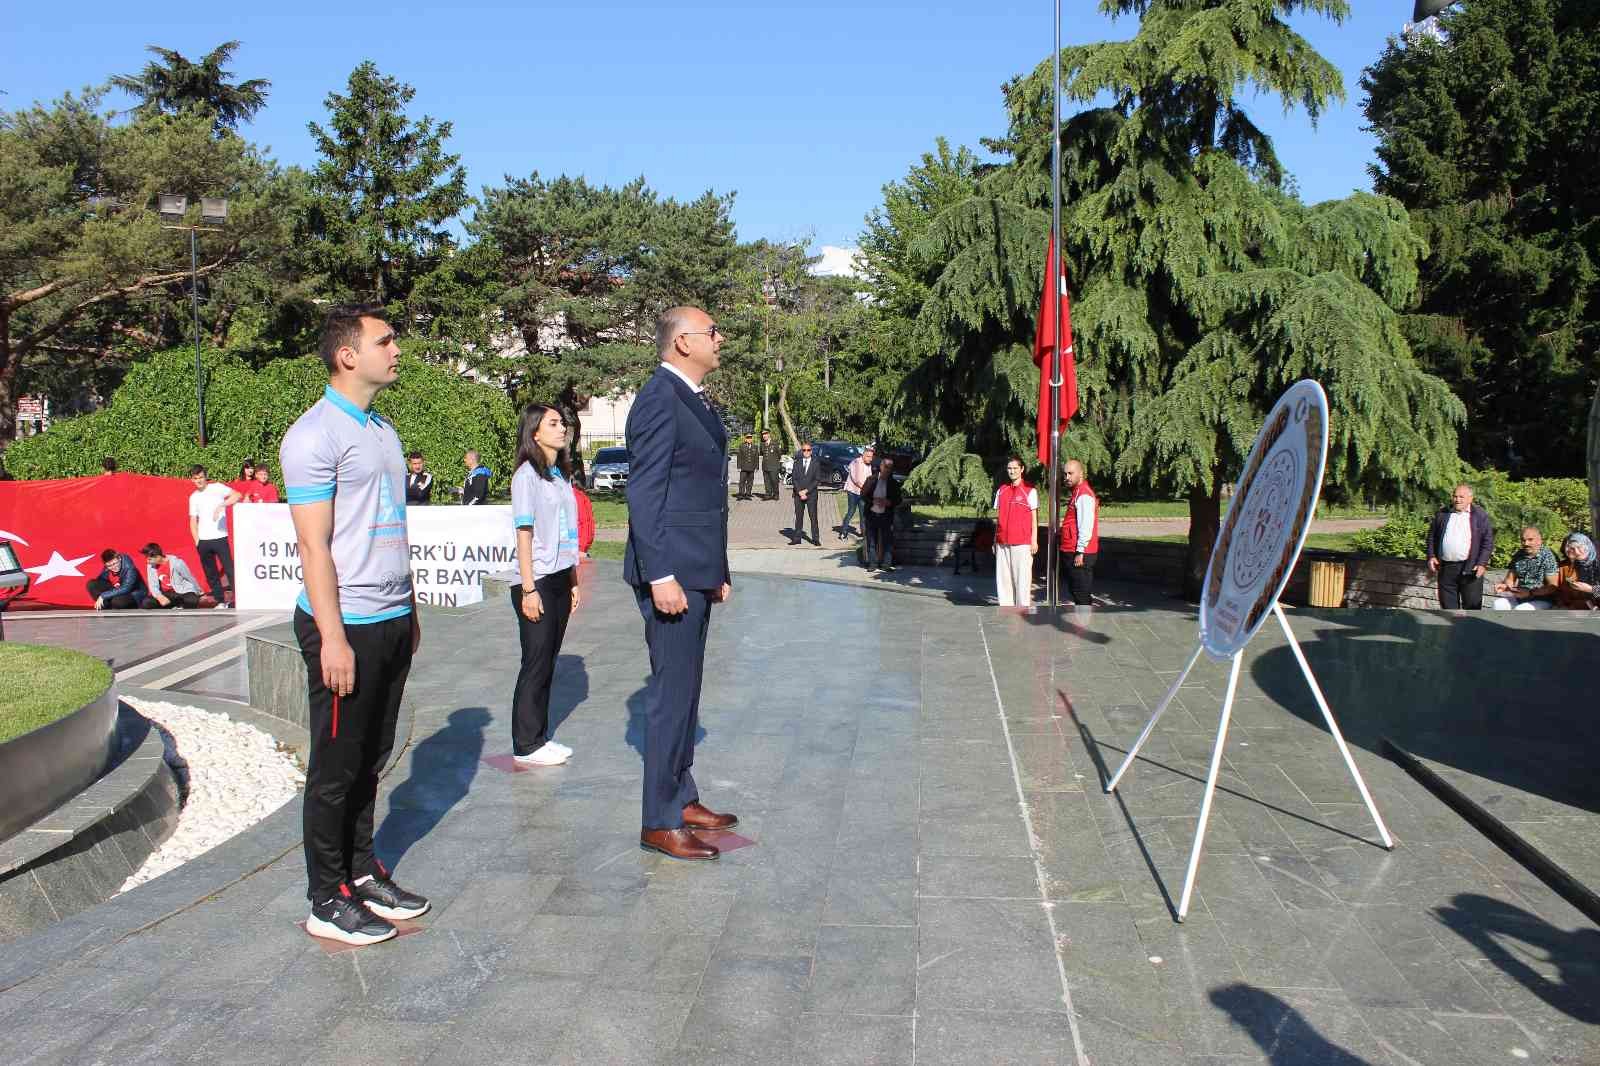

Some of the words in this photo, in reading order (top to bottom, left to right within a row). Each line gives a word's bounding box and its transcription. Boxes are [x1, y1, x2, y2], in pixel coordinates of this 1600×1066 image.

[259, 541, 279, 557] 19
[285, 542, 301, 558] M
[409, 541, 456, 561] RK'Ü
[254, 564, 304, 584] GENÇ
[436, 569, 489, 586] BAYR
[416, 591, 457, 608] SUN
